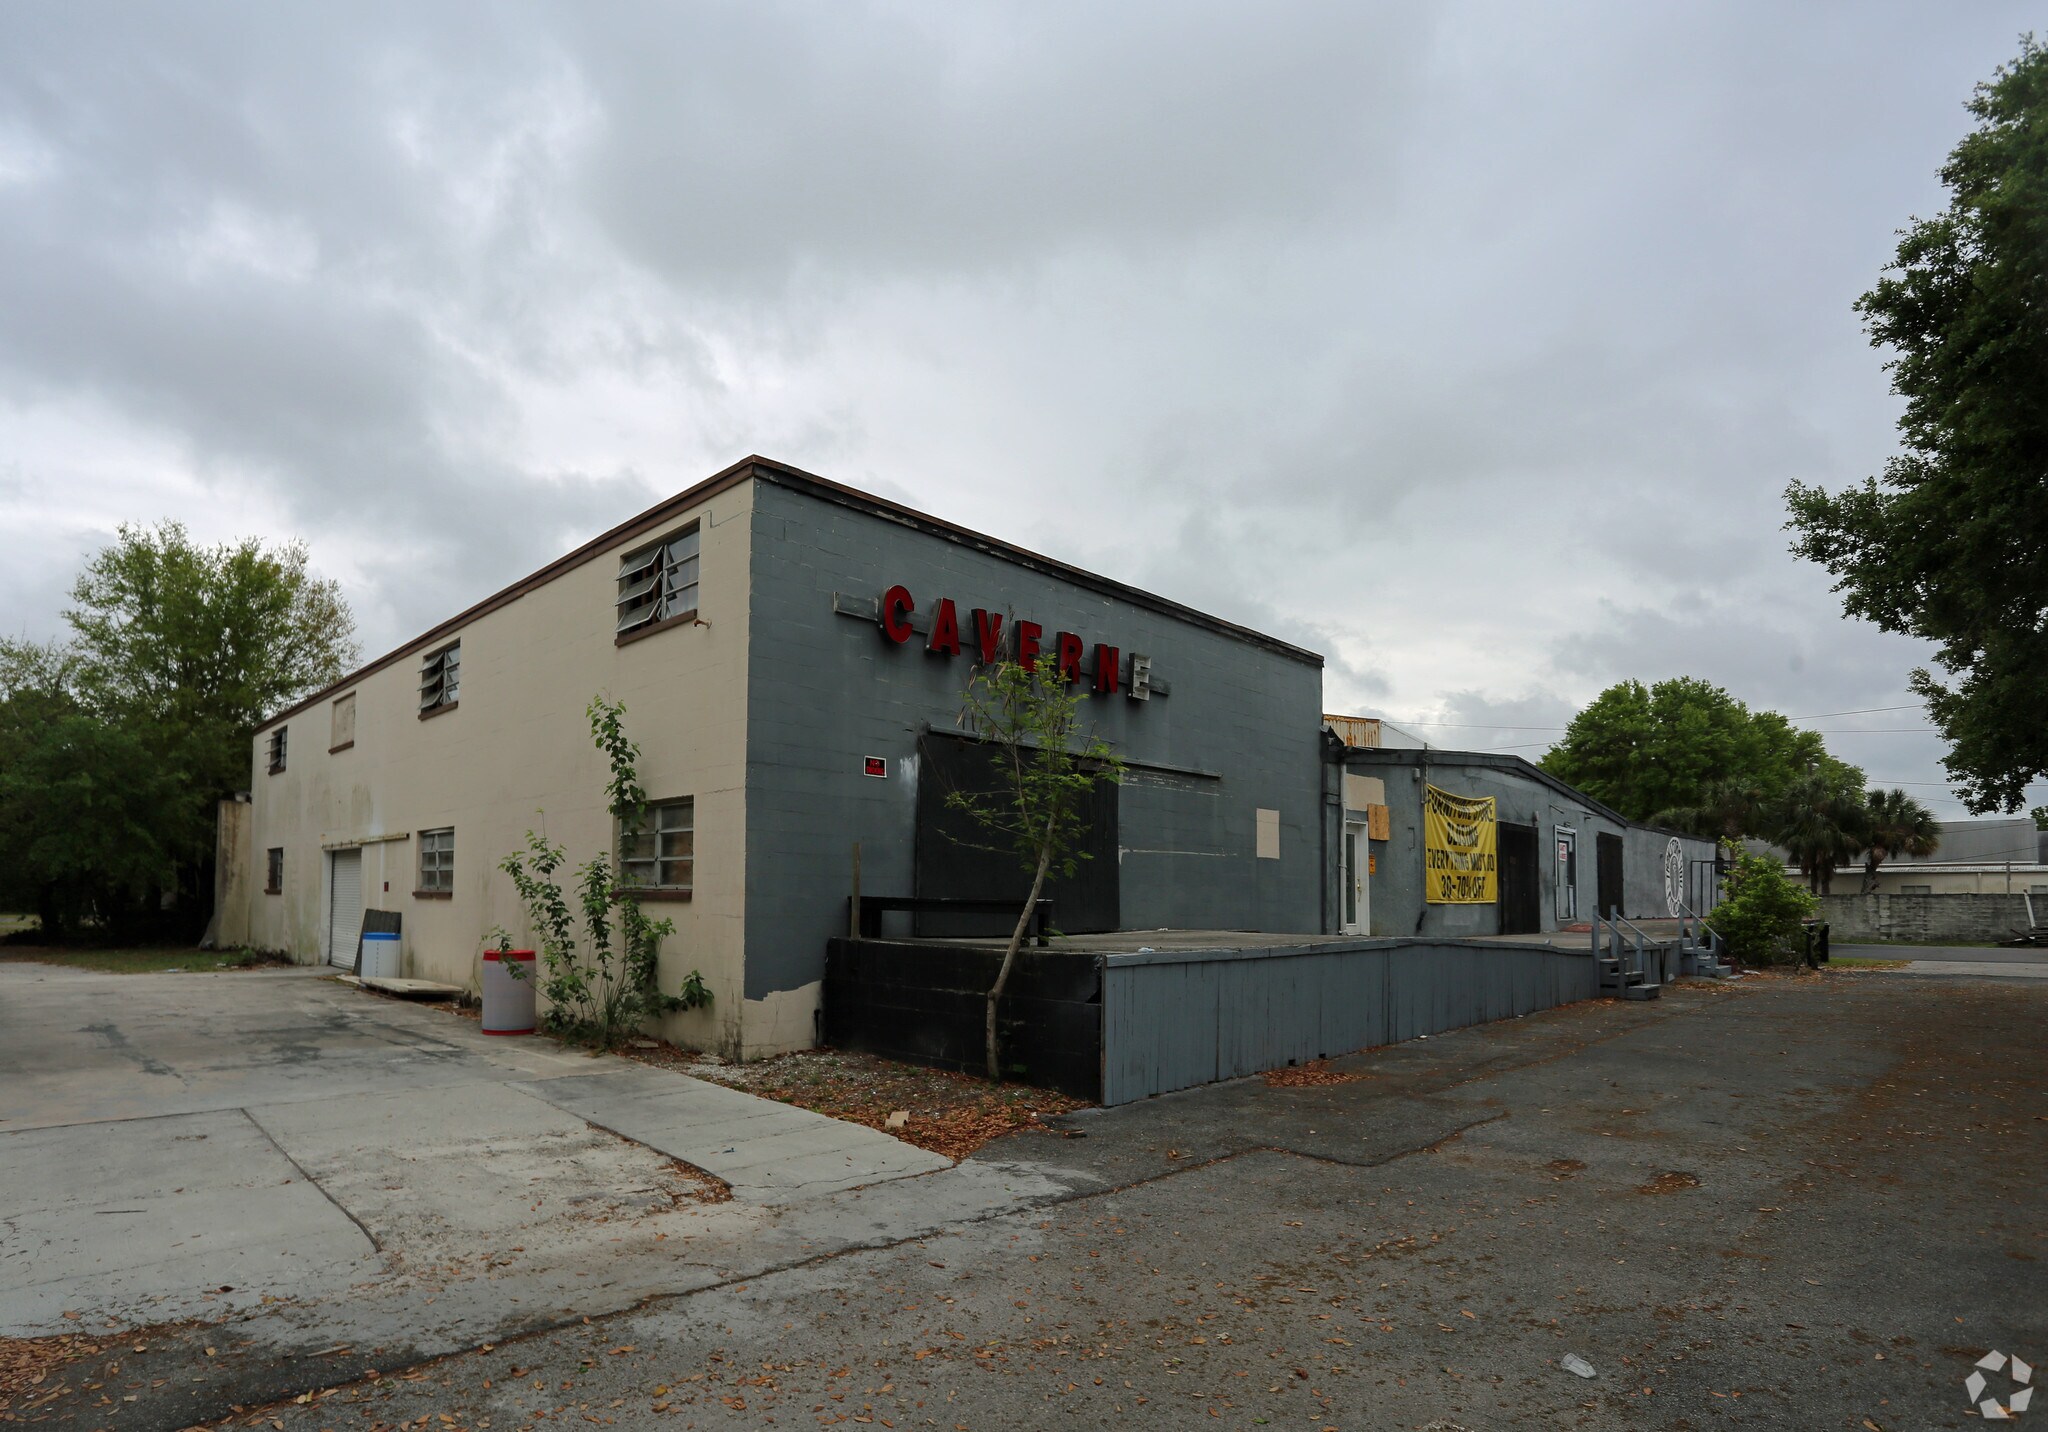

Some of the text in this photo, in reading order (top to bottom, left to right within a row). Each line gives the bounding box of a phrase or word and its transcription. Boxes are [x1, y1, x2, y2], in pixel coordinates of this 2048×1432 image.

[881, 585, 1150, 701] CAVERNE
[1427, 848, 1469, 871] EVERYTHING
[1473, 876, 1486, 898] OFF
